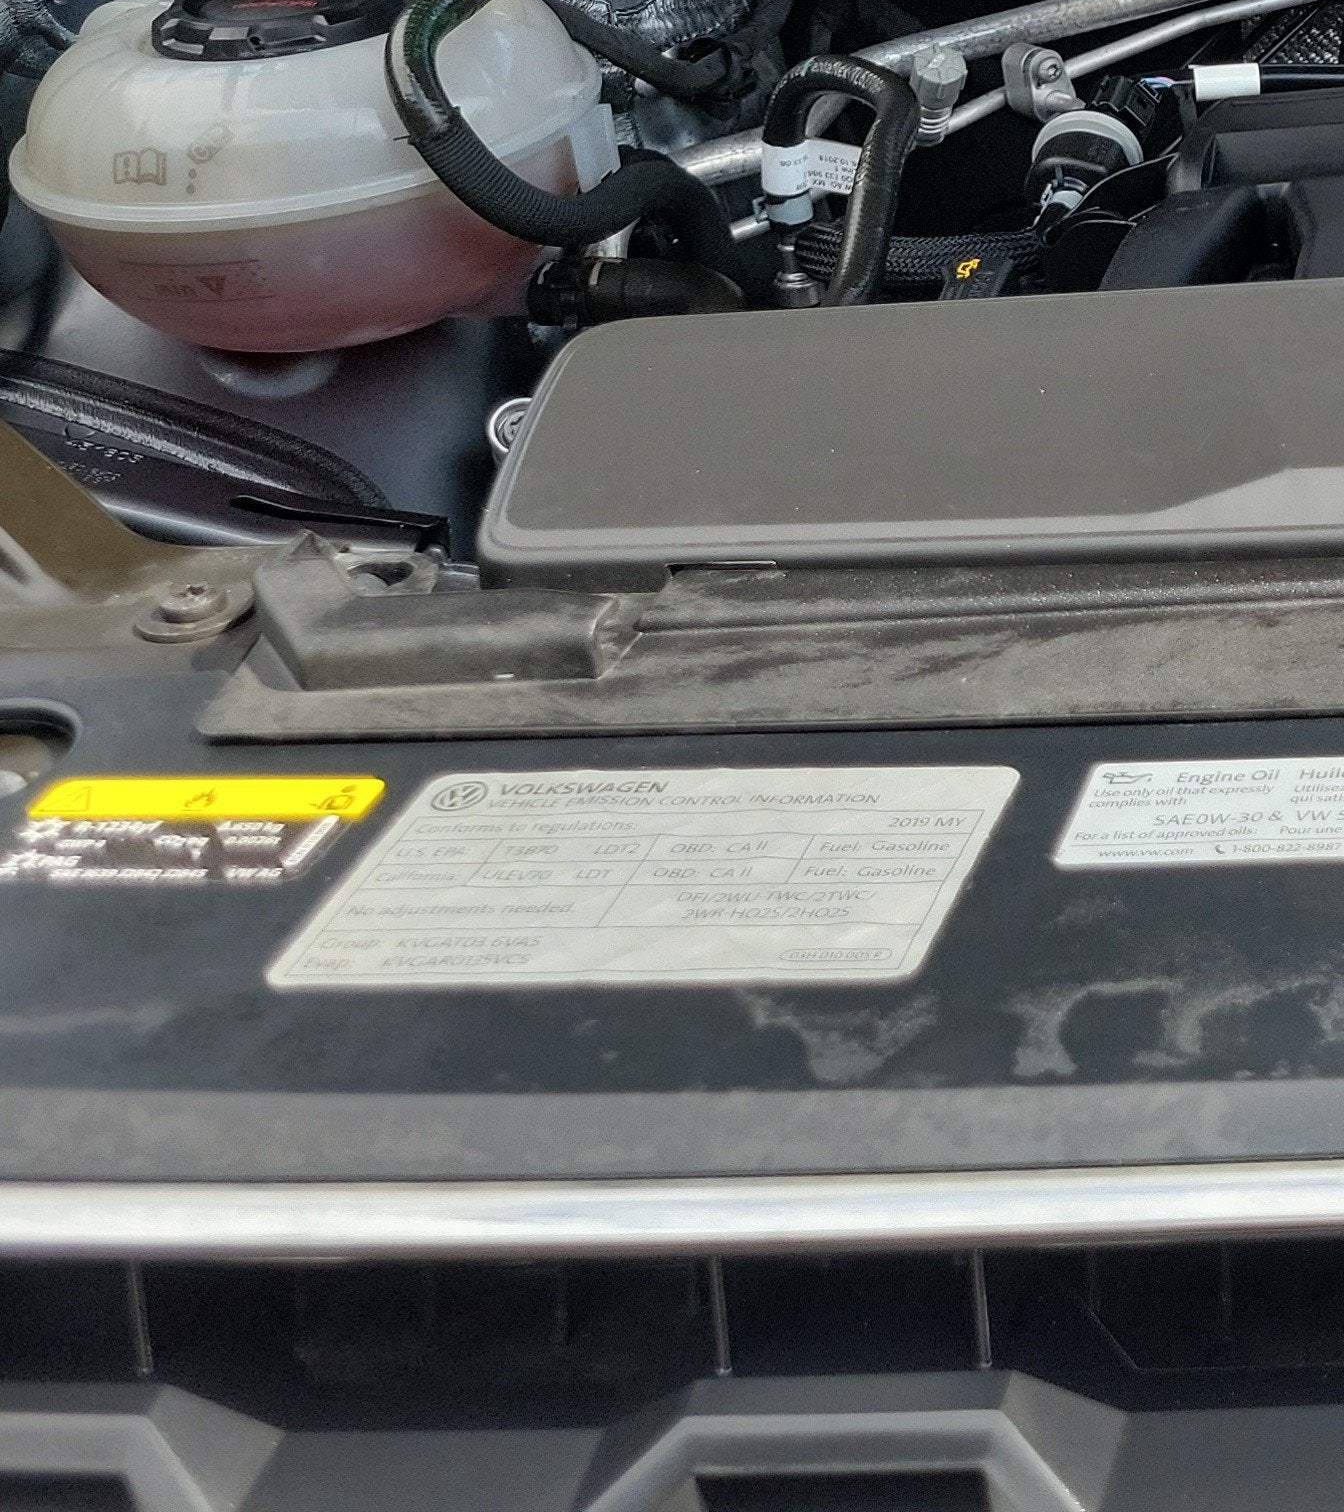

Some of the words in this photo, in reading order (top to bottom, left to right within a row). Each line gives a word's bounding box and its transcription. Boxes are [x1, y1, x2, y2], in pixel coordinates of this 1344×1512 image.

[1174, 769, 1247, 786] Engine
[1249, 768, 1281, 781] Oil
[501, 780, 671, 796] VOLKSWAGEN
[1093, 787, 1122, 797] Use
[1121, 788, 1154, 798] only
[1154, 785, 1175, 796] oil
[1176, 784, 1208, 795] that
[1207, 783, 1276, 796] expressly
[489, 798, 563, 809] VEHICLE
[565, 794, 656, 807] EMISSION
[659, 794, 742, 806] CONTROL
[748, 793, 880, 805] INFORMATION
[1087, 798, 1153, 810] complies
[1154, 796, 1188, 806] with
[888, 816, 931, 828] 2019
[934, 816, 968, 828] MY
[1266, 809, 1285, 821] &
[1293, 808, 1332, 822] VW
[415, 822, 503, 834] Conforms
[1073, 830, 1098, 841] For
[1112, 829, 1136, 839] list
[1136, 828, 1156, 838] of
[1155, 826, 1226, 841] approved
[1277, 824, 1313, 835] Pour
[1314, 824, 1343, 834] une
[593, 843, 640, 855] LDT2
[670, 843, 717, 854] OBD:
[726, 842, 752, 854] CA
[820, 840, 862, 852] Fuel:
[871, 840, 951, 852] Gasoline
[1097, 846, 1195, 857] www.vw.com
[576, 868, 616, 880] LDT
[710, 867, 736, 879] CA
[804, 865, 846, 877] Fuel:
[857, 864, 936, 877] Gasoline
